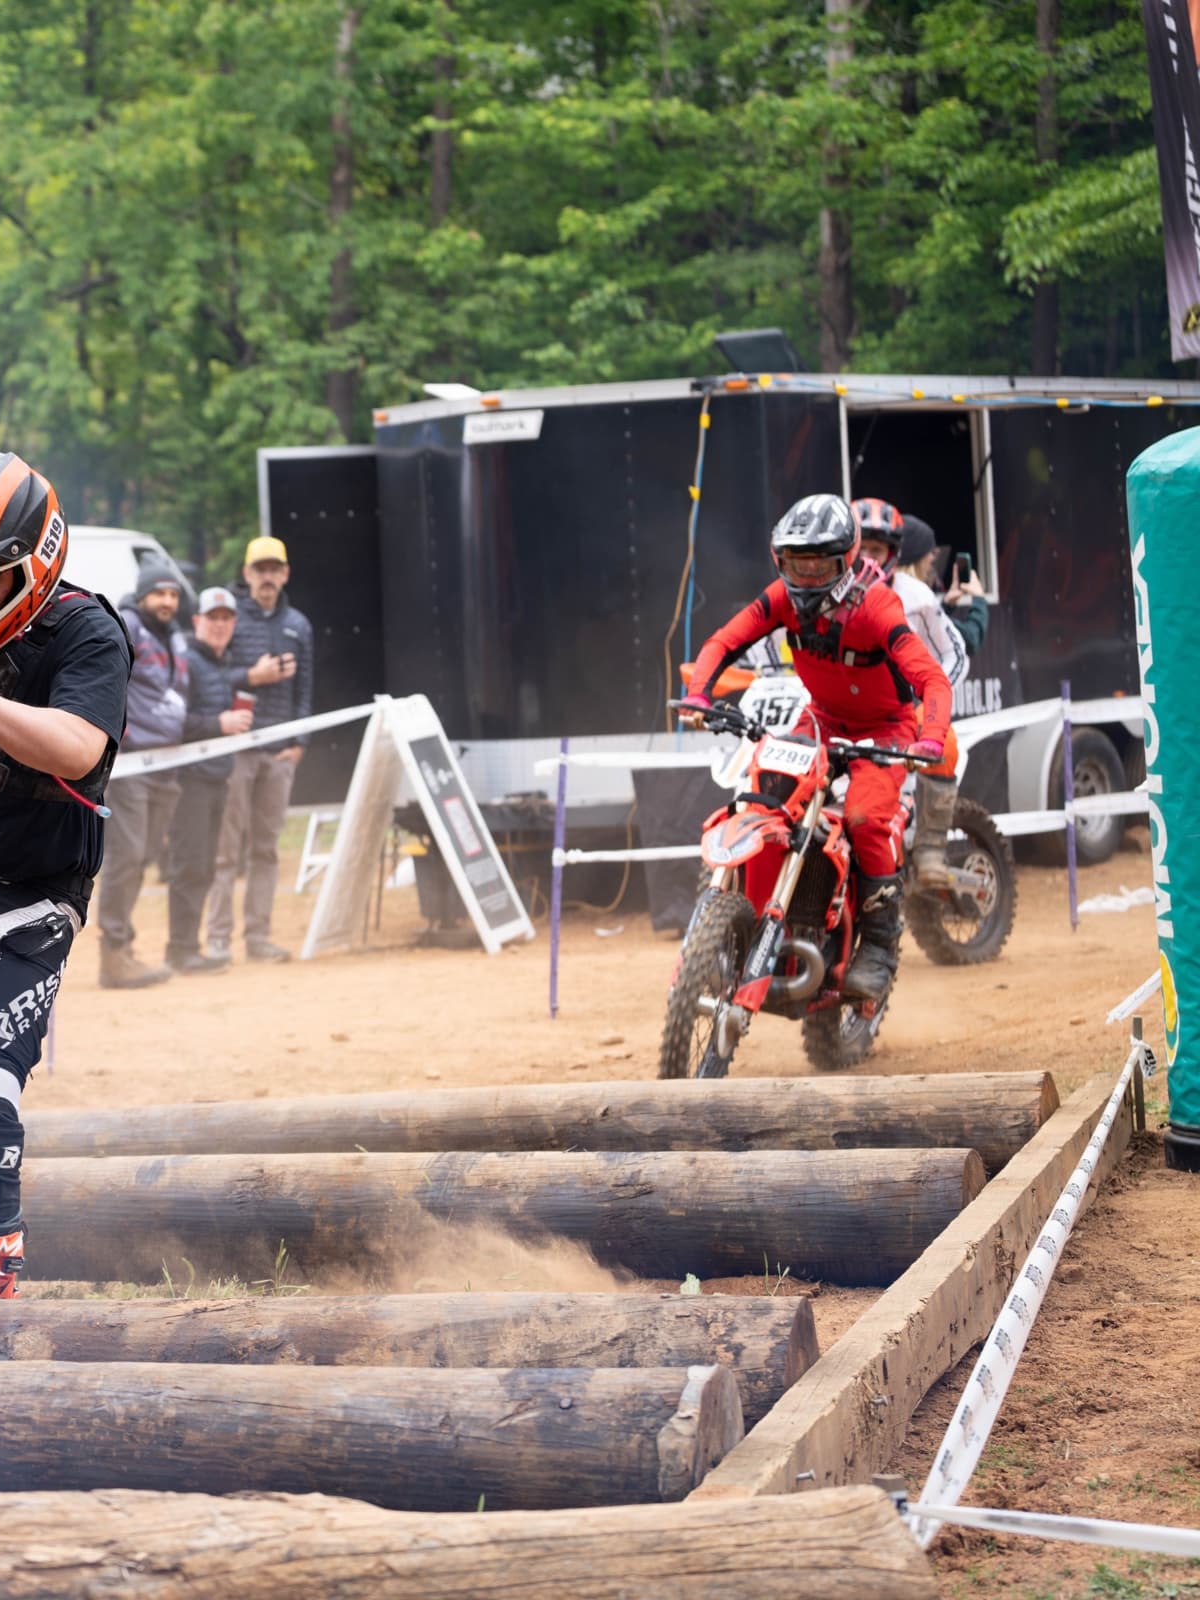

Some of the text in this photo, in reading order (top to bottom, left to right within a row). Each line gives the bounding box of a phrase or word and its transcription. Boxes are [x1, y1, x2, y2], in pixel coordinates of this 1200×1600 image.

[39, 517, 64, 562] 1519
[752, 696, 801, 726] 357
[763, 745, 811, 766] 2299
